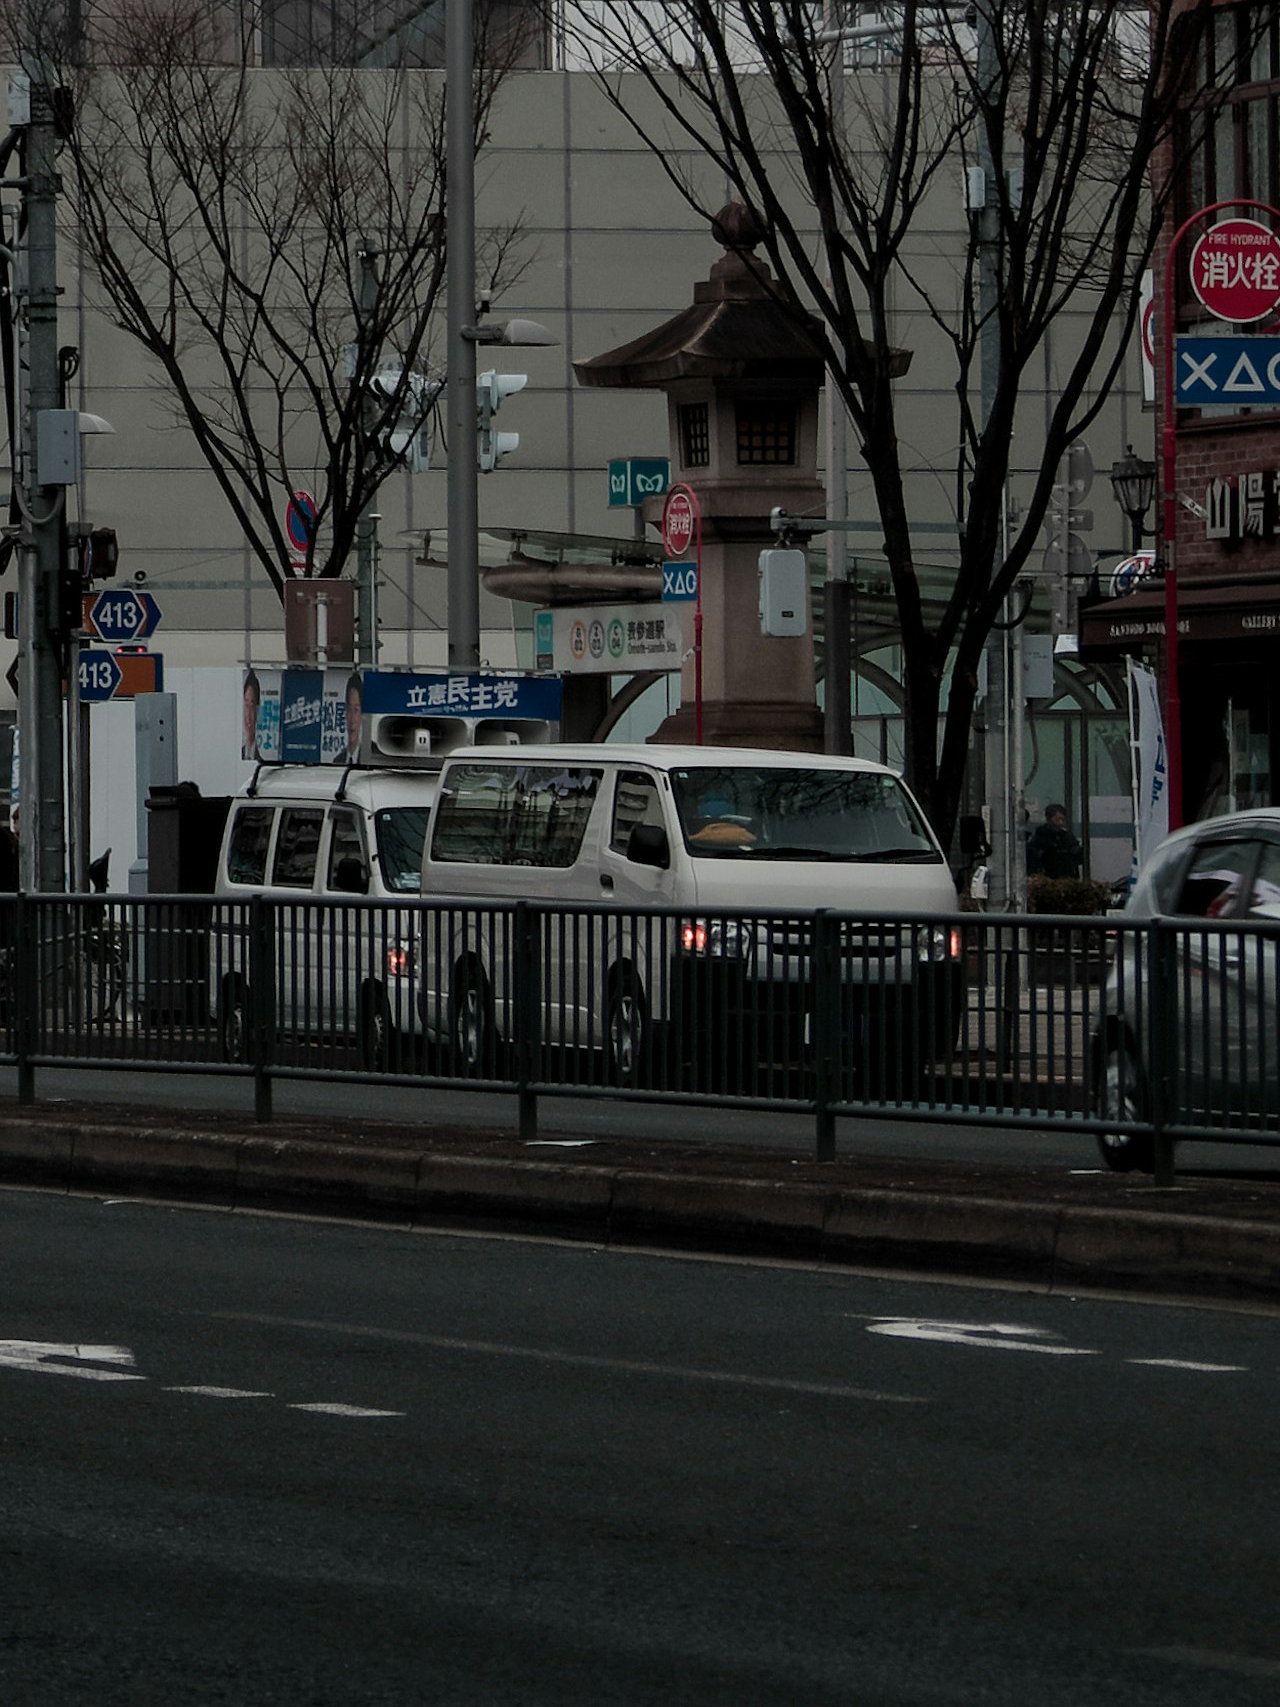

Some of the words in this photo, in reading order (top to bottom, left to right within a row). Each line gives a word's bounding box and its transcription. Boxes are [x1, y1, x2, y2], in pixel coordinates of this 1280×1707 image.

[1208, 233, 1228, 245] FIRE
[1230, 234, 1271, 246] HYDRANT
[1201, 250, 1280, 291] 消火栓
[1206, 471, 1280, 539] 山陽
[99, 601, 137, 628] 413
[628, 620, 665, 640] 表参道駅
[78, 662, 113, 689] 413
[406, 676, 519, 711] 立憲民主党
